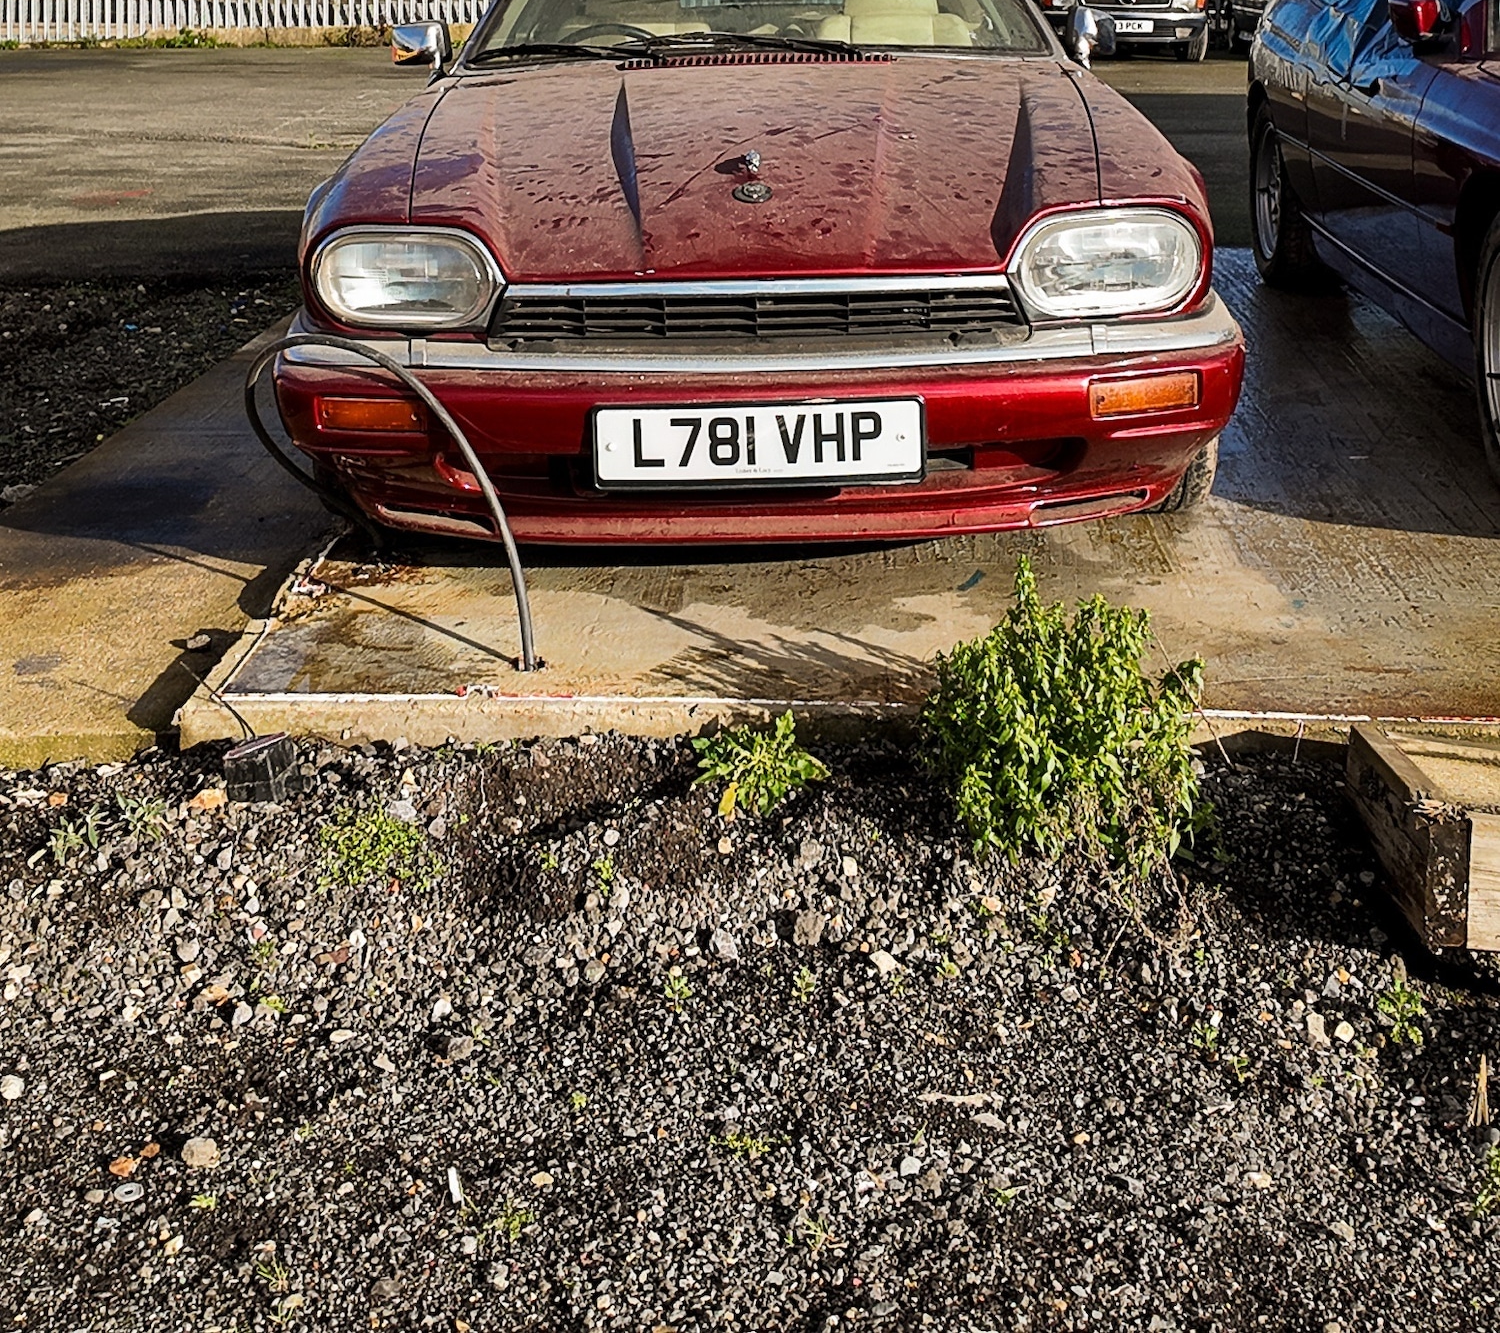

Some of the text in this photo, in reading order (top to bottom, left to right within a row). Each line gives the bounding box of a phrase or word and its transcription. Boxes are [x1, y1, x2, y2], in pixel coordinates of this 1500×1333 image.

[1126, 21, 1143, 30] PCK
[632, 411, 882, 468] L781 VHP
